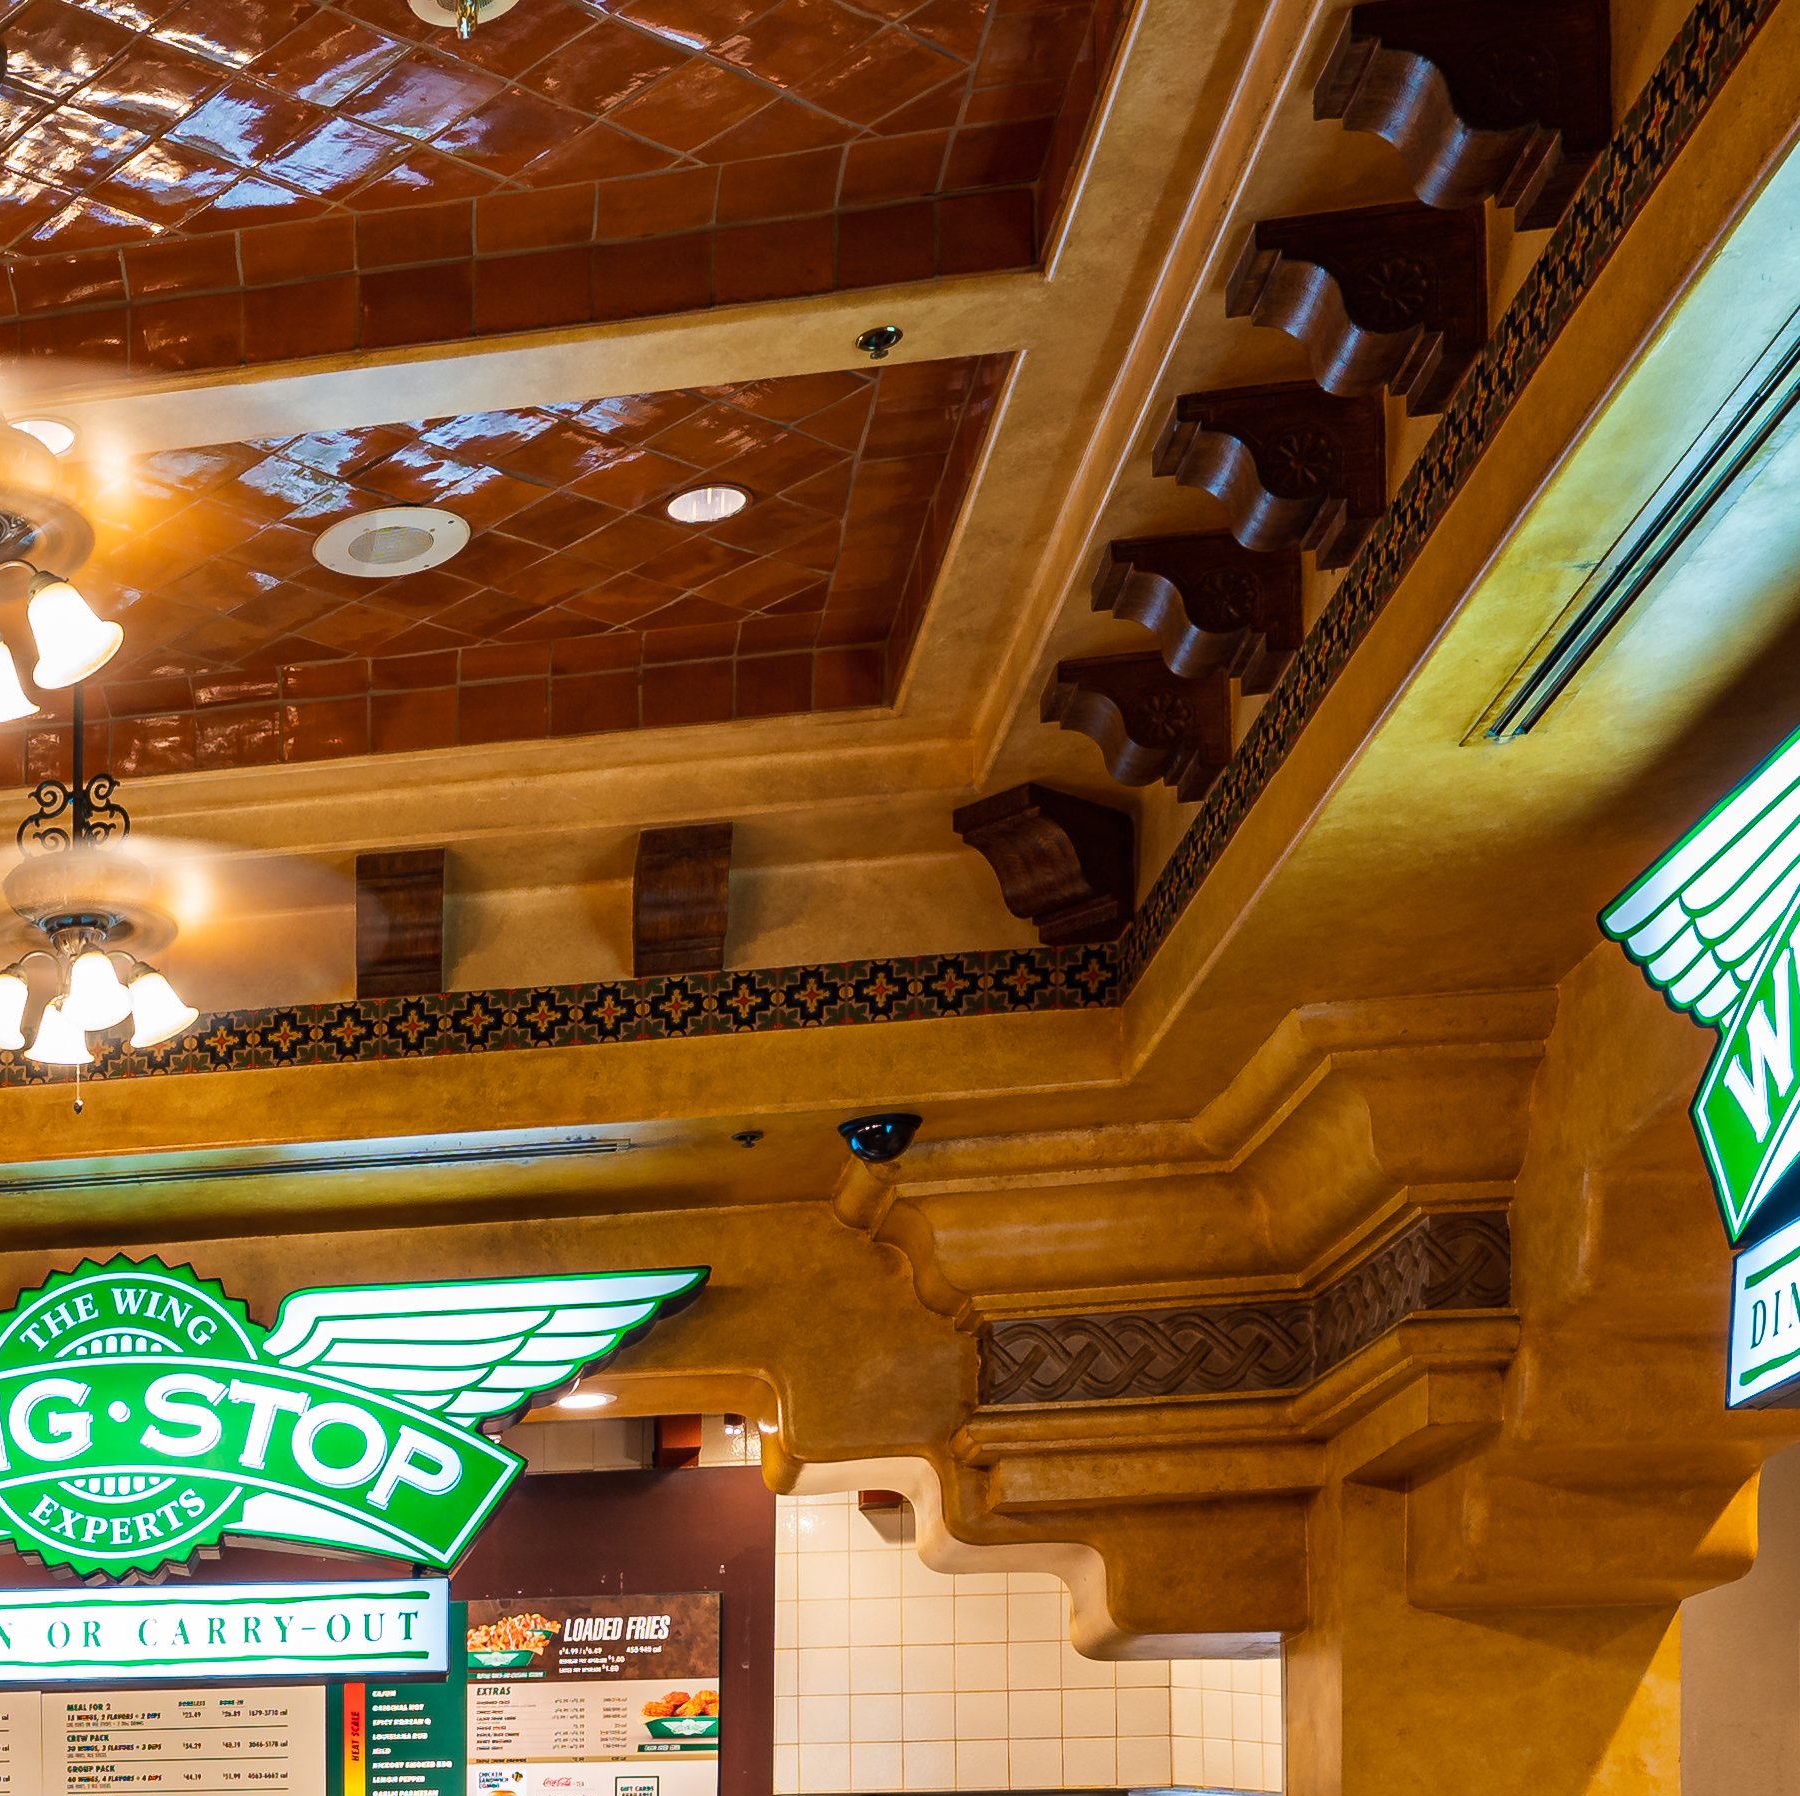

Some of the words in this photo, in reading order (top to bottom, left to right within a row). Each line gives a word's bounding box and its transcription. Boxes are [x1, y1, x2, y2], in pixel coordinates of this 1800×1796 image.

[19, 1293, 97, 1351] THE
[111, 1288, 218, 1346] WING
[141, 1372, 463, 1511] STOP
[30, 1488, 207, 1546] EXPERTS
[46, 1620, 103, 1650] OR
[138, 1610, 420, 1647] CARRY-OUT
[563, 1617, 624, 1642] LOADED
[625, 1615, 671, 1640] FRIES
[477, 1686, 511, 1696] EXTRAS
[66, 1703, 87, 1711] MEAL
[89, 1703, 103, 1711] FOR
[106, 1703, 111, 1711] 2
[351, 1711, 360, 1736] SCALE
[351, 1738, 360, 1761] HEAT
[67, 1765, 94, 1773] GROUP
[96, 1765, 115, 1773] PACK
